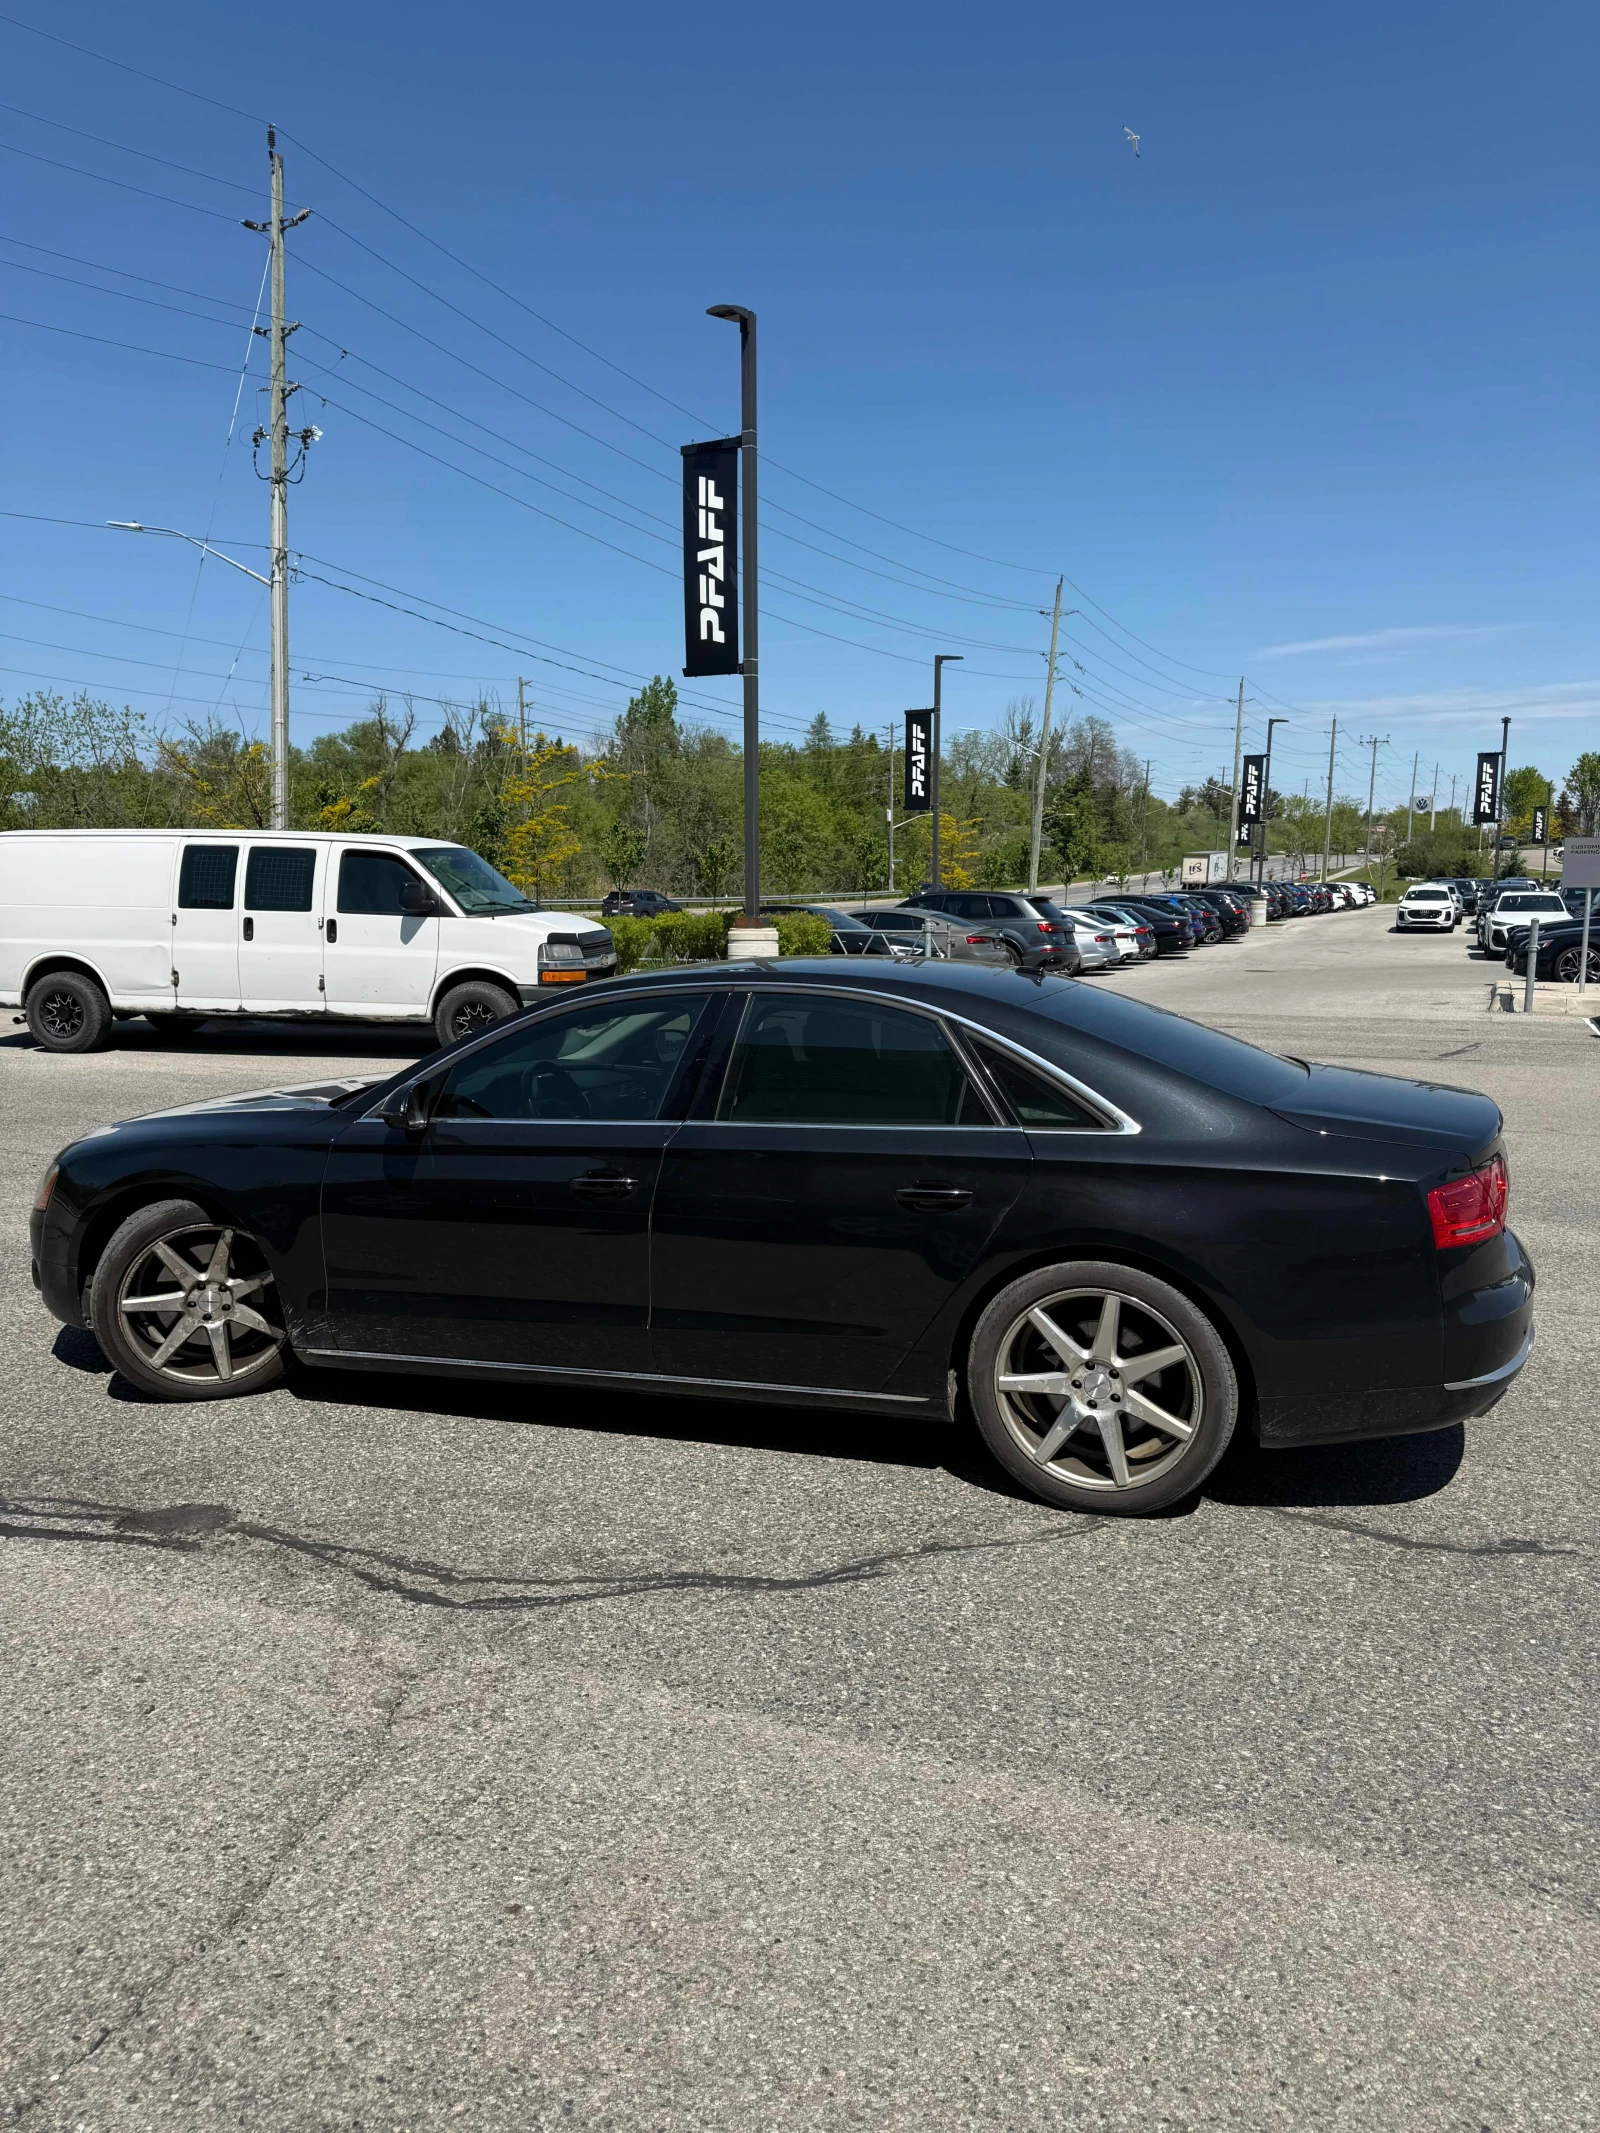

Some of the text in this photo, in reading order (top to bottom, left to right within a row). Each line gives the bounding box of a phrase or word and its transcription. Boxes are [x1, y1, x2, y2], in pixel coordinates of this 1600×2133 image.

[697, 476, 725, 643] PFAFF
[911, 723, 926, 797] PFAFF
[1245, 764, 1259, 815] PFAFF
[1480, 762, 1494, 813] PFAFF
[1535, 811, 1543, 840] PFAFF
